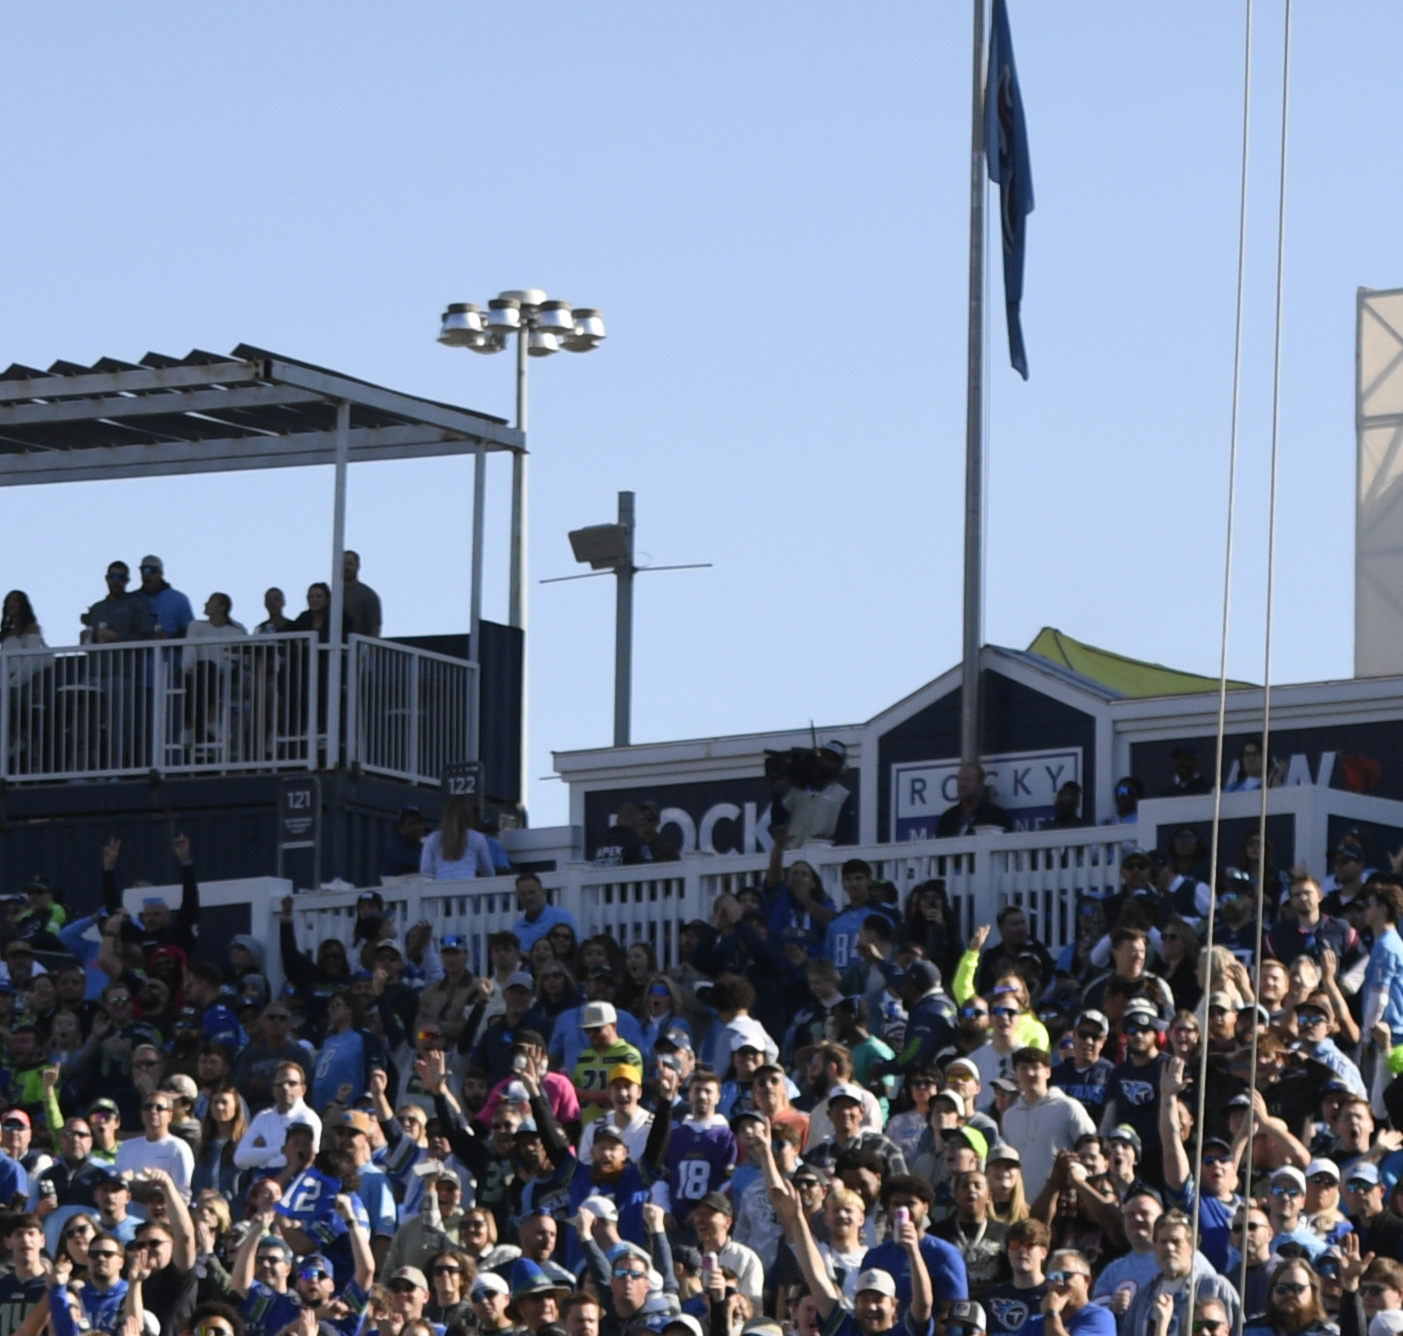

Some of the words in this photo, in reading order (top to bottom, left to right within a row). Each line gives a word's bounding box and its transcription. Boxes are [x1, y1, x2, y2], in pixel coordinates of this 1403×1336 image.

[287, 790, 311, 809] 121
[448, 776, 476, 795] 122
[279, 1172, 322, 1213] 12
[677, 1159, 711, 1200] 18
